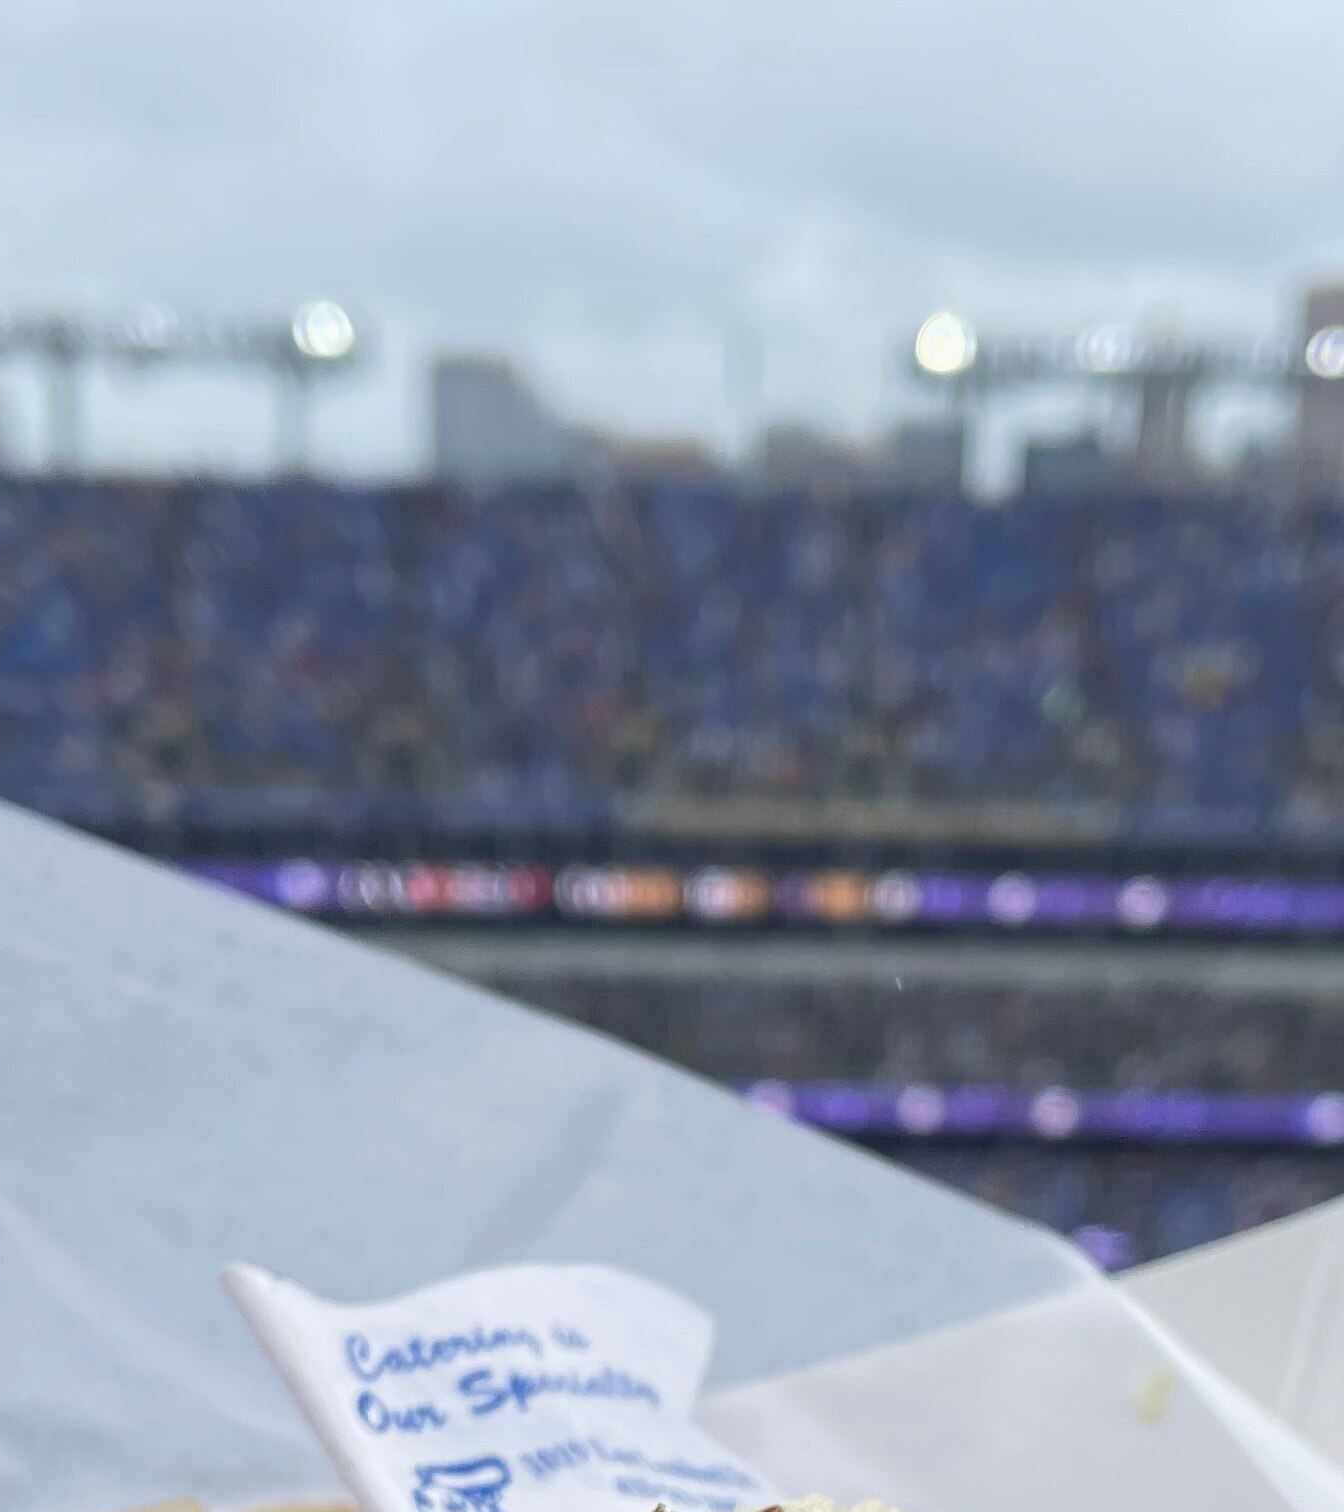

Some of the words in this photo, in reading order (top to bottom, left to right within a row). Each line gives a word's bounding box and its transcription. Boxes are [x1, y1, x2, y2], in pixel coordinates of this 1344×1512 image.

[344, 1328, 543, 1381] Catering
[357, 1389, 447, 1434] Our
[458, 1366, 661, 1414] Specialty
